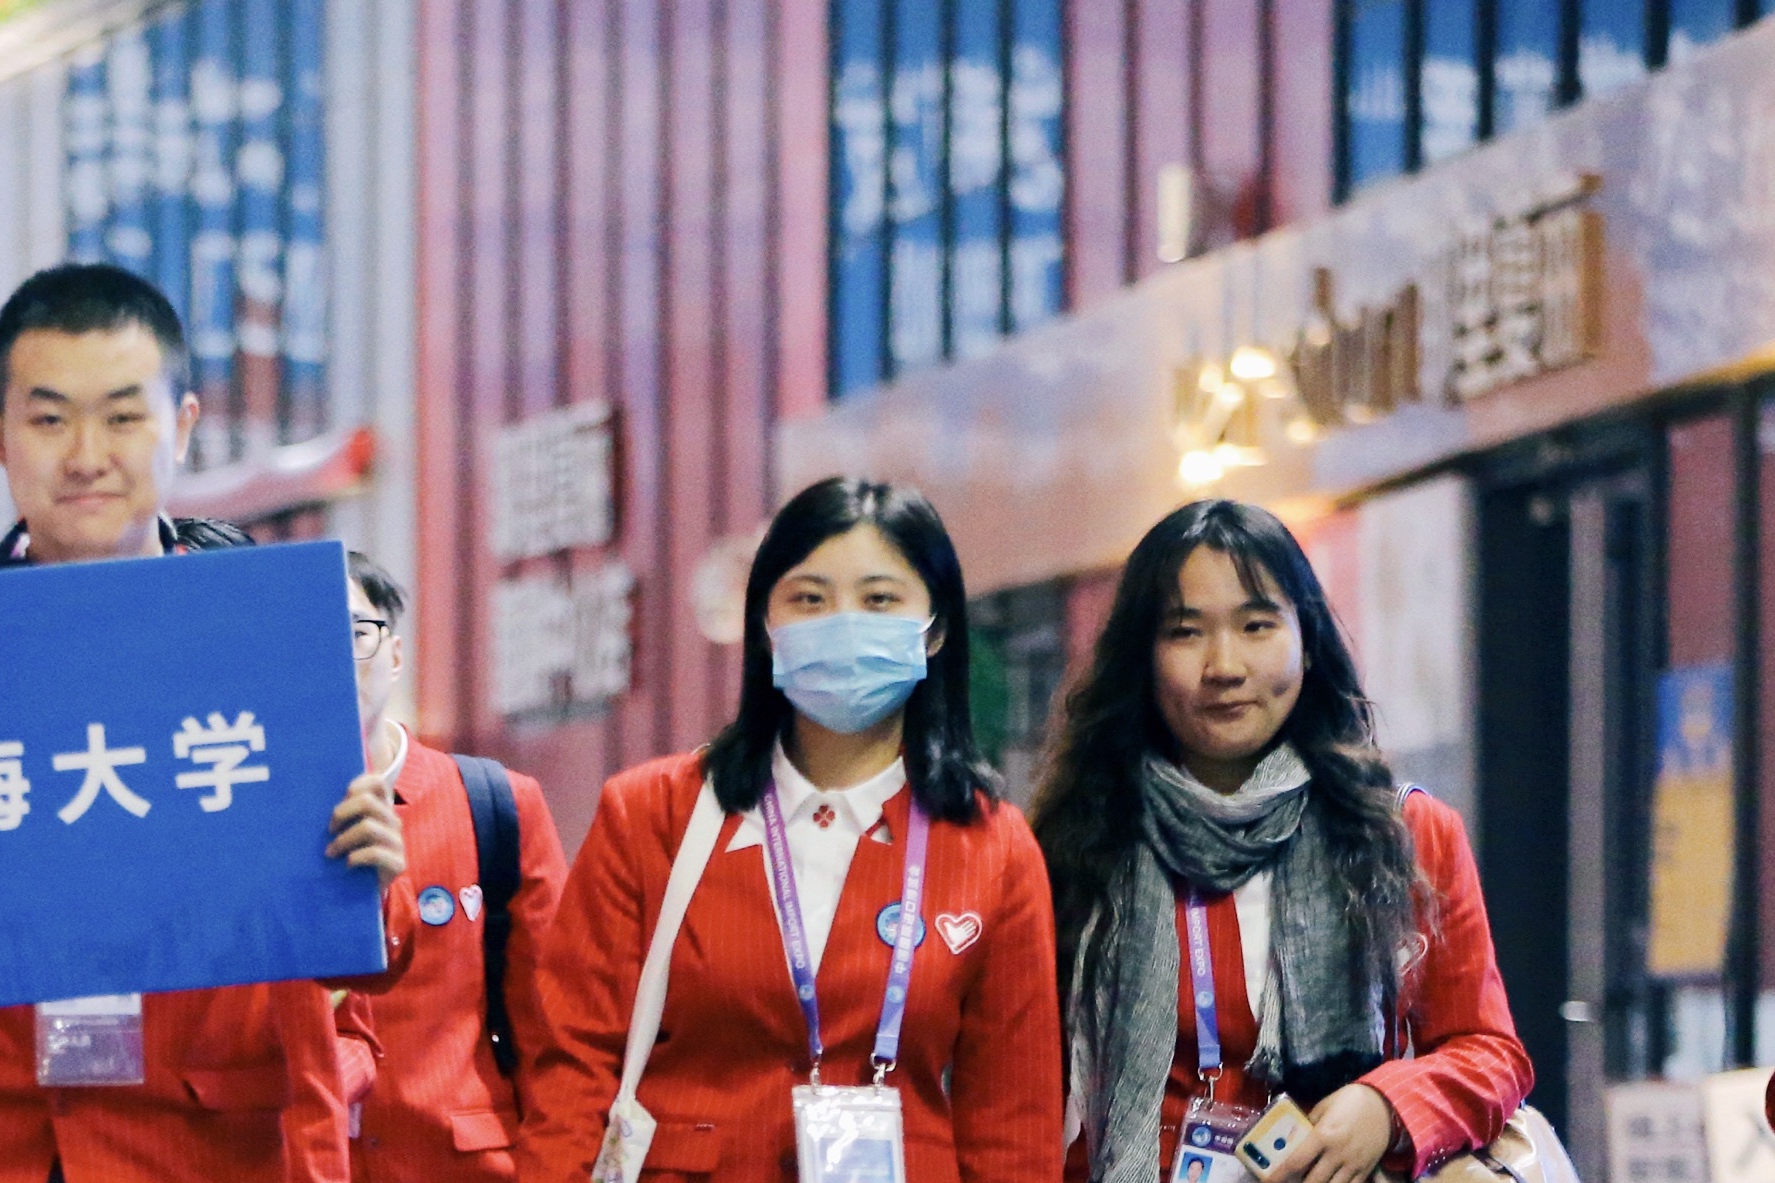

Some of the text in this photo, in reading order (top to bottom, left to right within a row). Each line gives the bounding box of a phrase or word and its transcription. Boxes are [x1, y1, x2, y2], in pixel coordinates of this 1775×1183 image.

[768, 826, 794, 900] INTERNATIONAL
[783, 901, 800, 938] IMPORT
[790, 940, 806, 970] EXPO
[1194, 948, 1206, 976] EXPO
